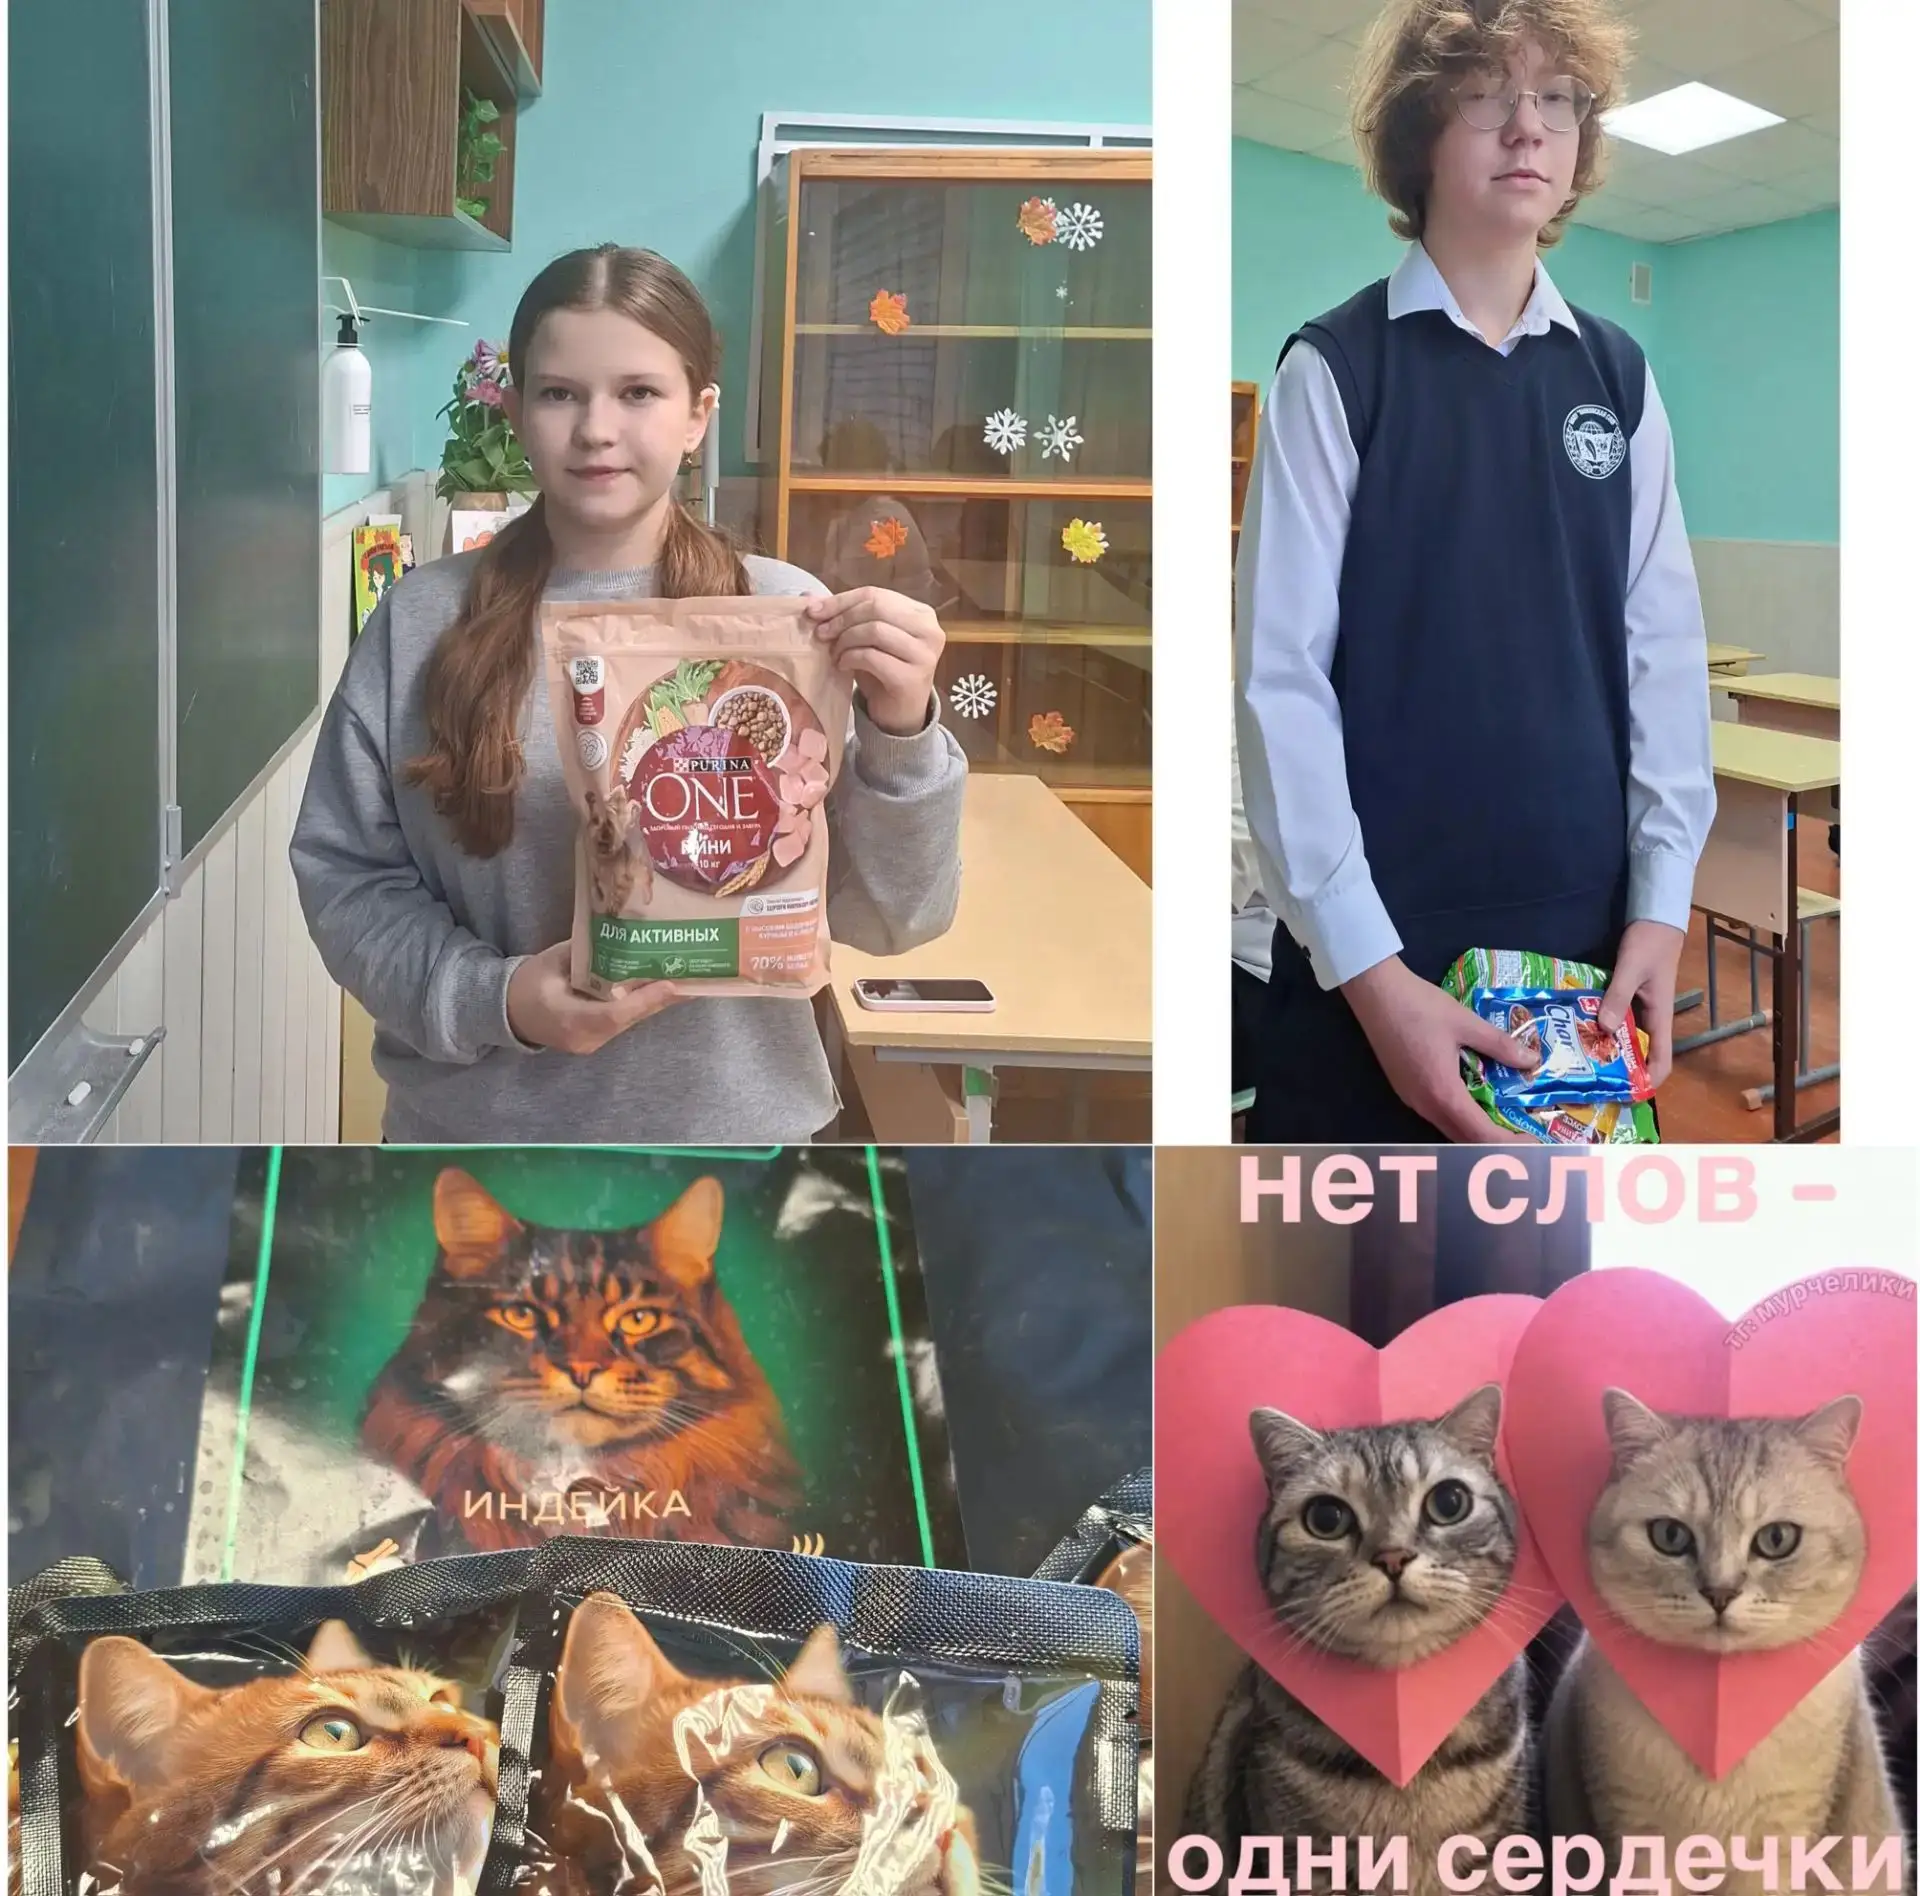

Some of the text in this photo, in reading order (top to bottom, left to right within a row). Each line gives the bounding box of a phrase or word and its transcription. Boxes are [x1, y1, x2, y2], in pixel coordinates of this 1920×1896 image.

[690, 759, 750, 771] PURINA
[646, 772, 759, 822] ONE
[600, 922, 720, 944] ДЛЯ АКТИВНЫХ
[750, 955, 784, 971] 70%
[464, 1486, 692, 1527] ИНДЕЙКА
